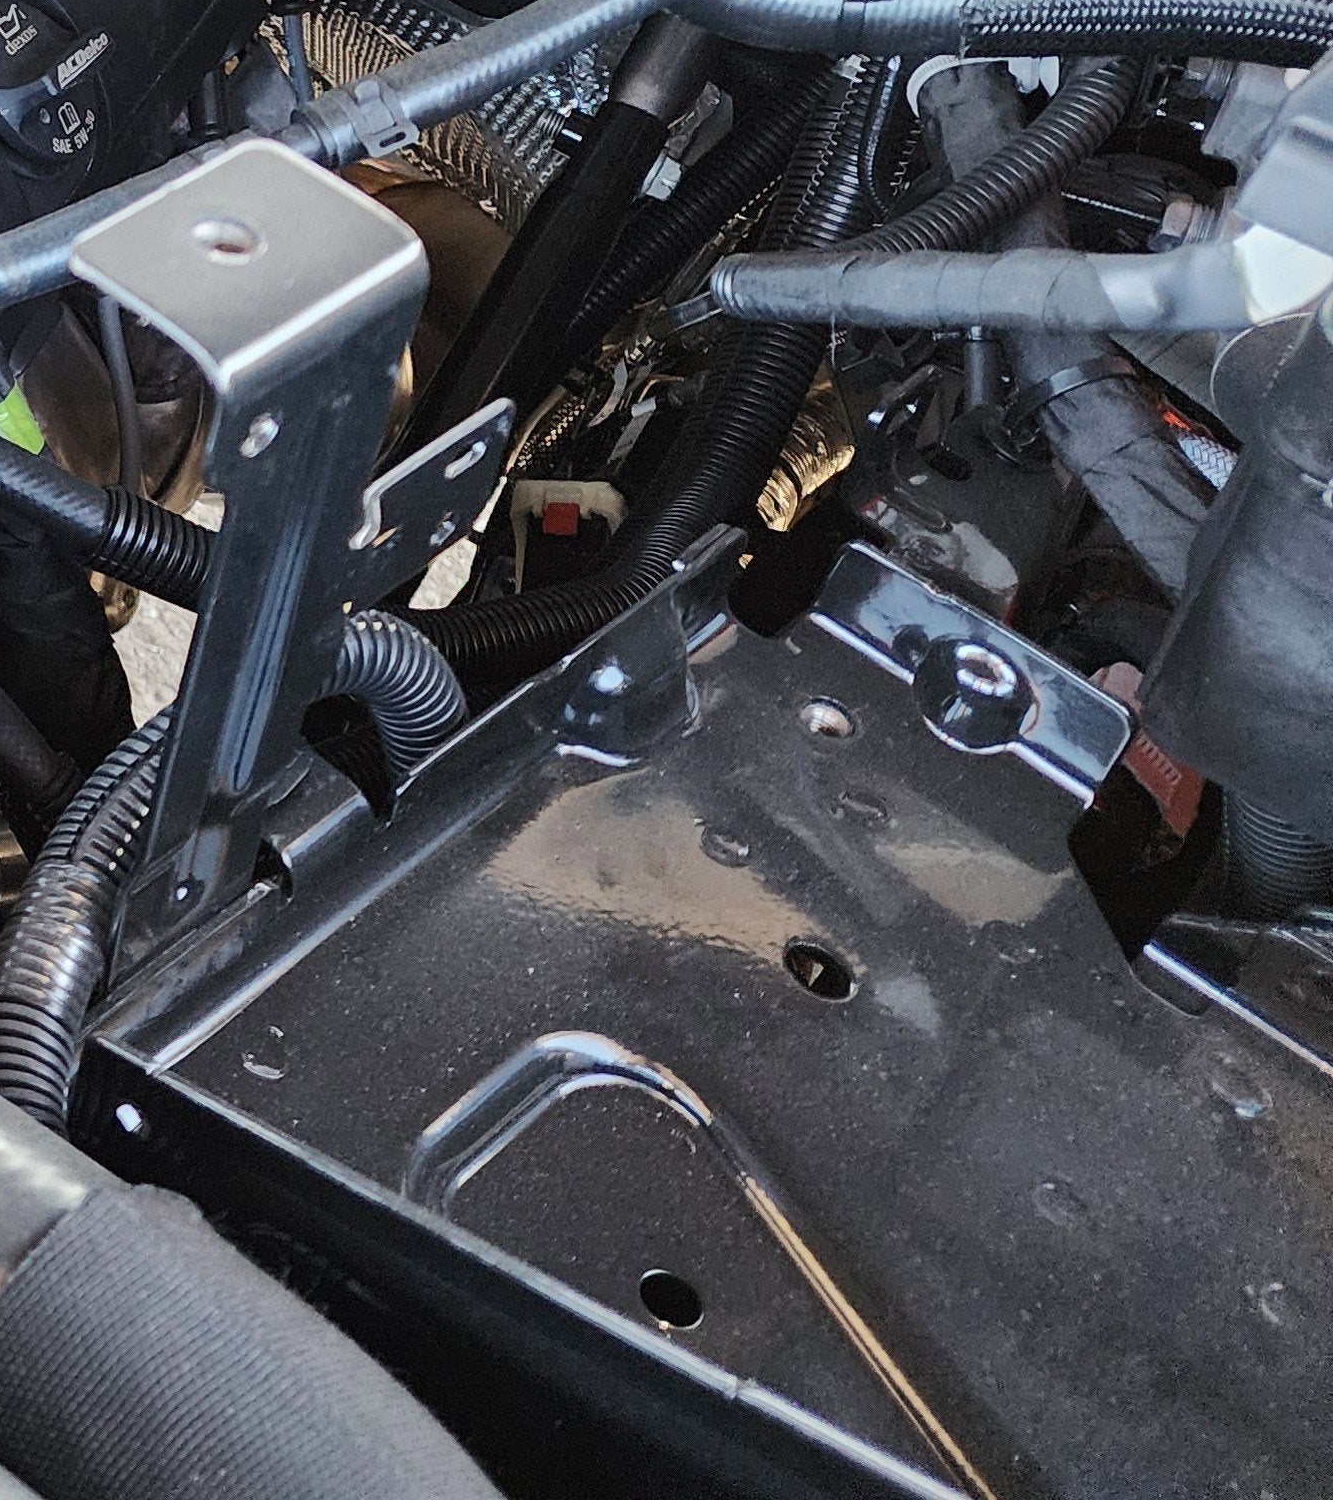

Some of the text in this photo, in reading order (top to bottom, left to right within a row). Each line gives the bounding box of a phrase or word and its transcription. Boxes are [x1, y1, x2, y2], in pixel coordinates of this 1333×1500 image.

[5, 25, 38, 55] dexos
[57, 32, 109, 84] ACDelco
[53, 137, 74, 154] SAE
